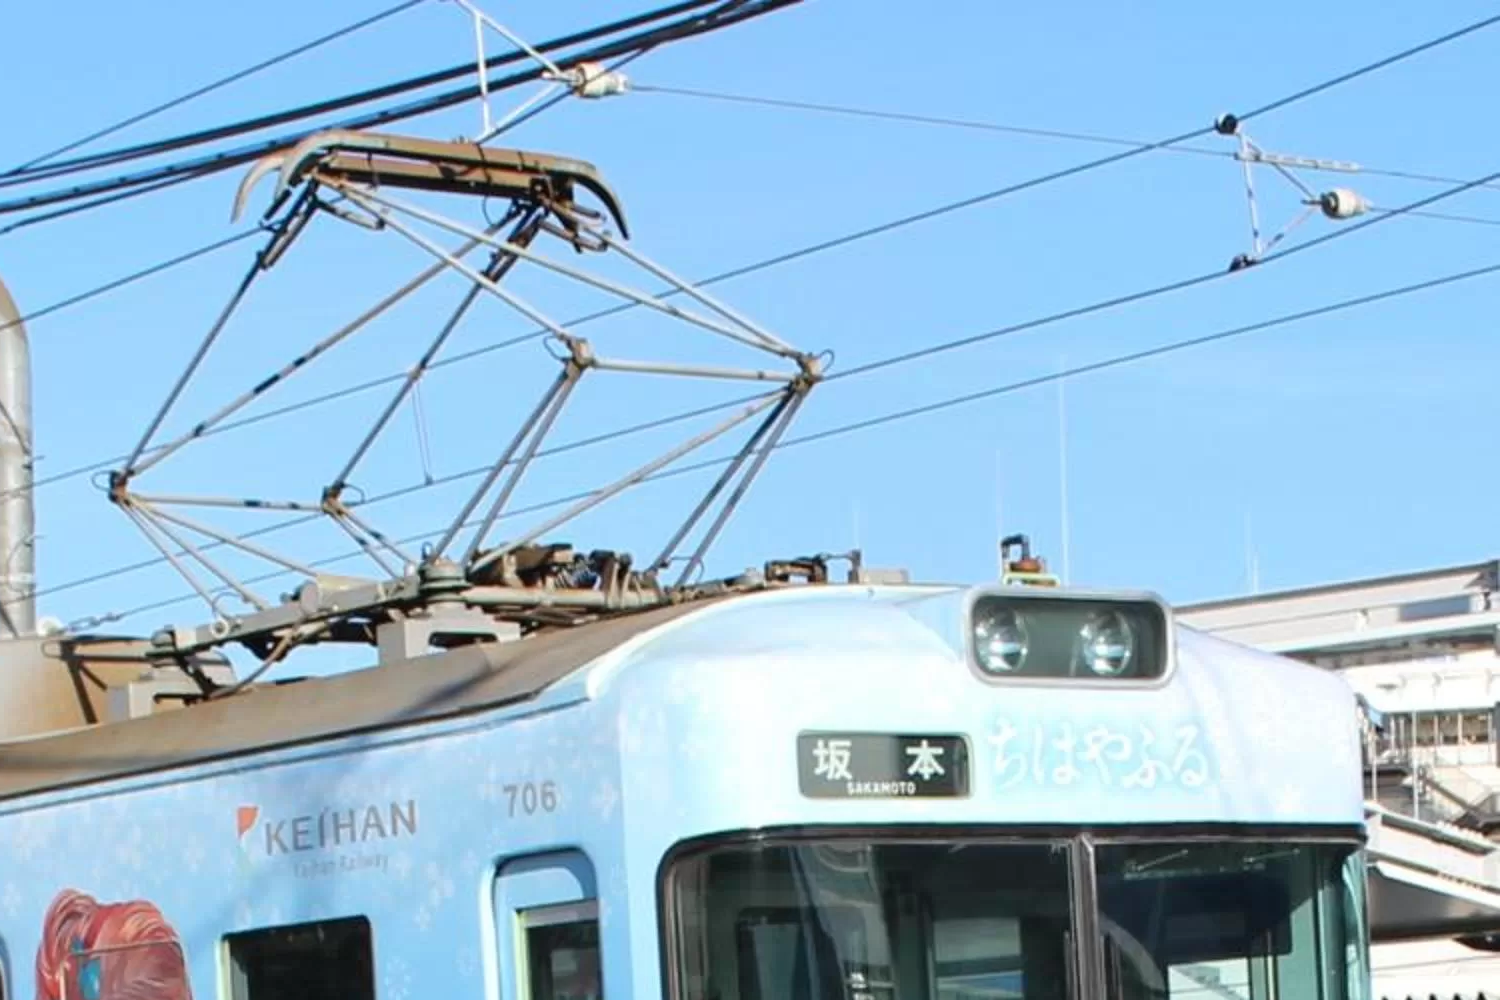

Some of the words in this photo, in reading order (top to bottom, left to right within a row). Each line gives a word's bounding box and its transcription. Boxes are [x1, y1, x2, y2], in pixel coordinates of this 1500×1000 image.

[812, 739, 945, 781] 坂本
[987, 713, 1209, 790] ちはやふる
[502, 780, 558, 818] 706
[846, 781, 917, 795] SAKAMOTO
[264, 799, 419, 856] KEIHAN
